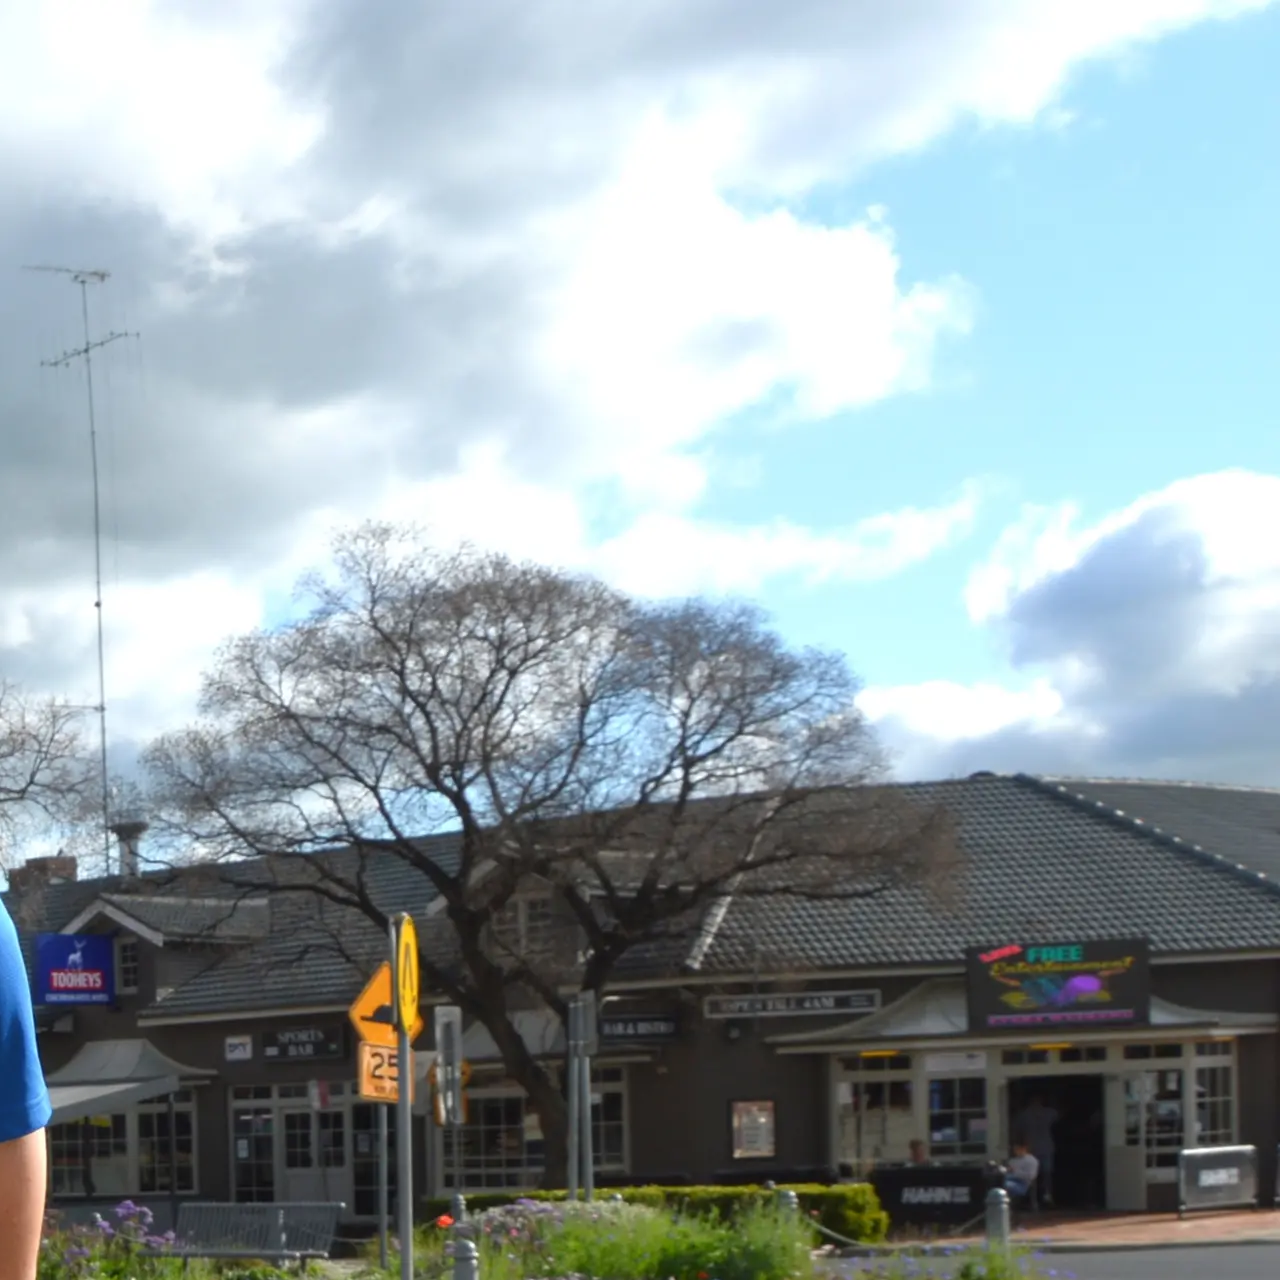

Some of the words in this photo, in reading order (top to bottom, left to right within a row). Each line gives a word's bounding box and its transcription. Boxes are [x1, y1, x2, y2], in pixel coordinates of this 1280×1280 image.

[1026, 945, 1083, 962] FREE
[51, 971, 102, 989] TOOHEYS
[802, 996, 835, 1009] 4AM
[276, 1029, 325, 1044] SPORTS
[287, 1044, 314, 1056] BAR
[371, 1052, 399, 1081] 25
[901, 1187, 952, 1204] HAHN
